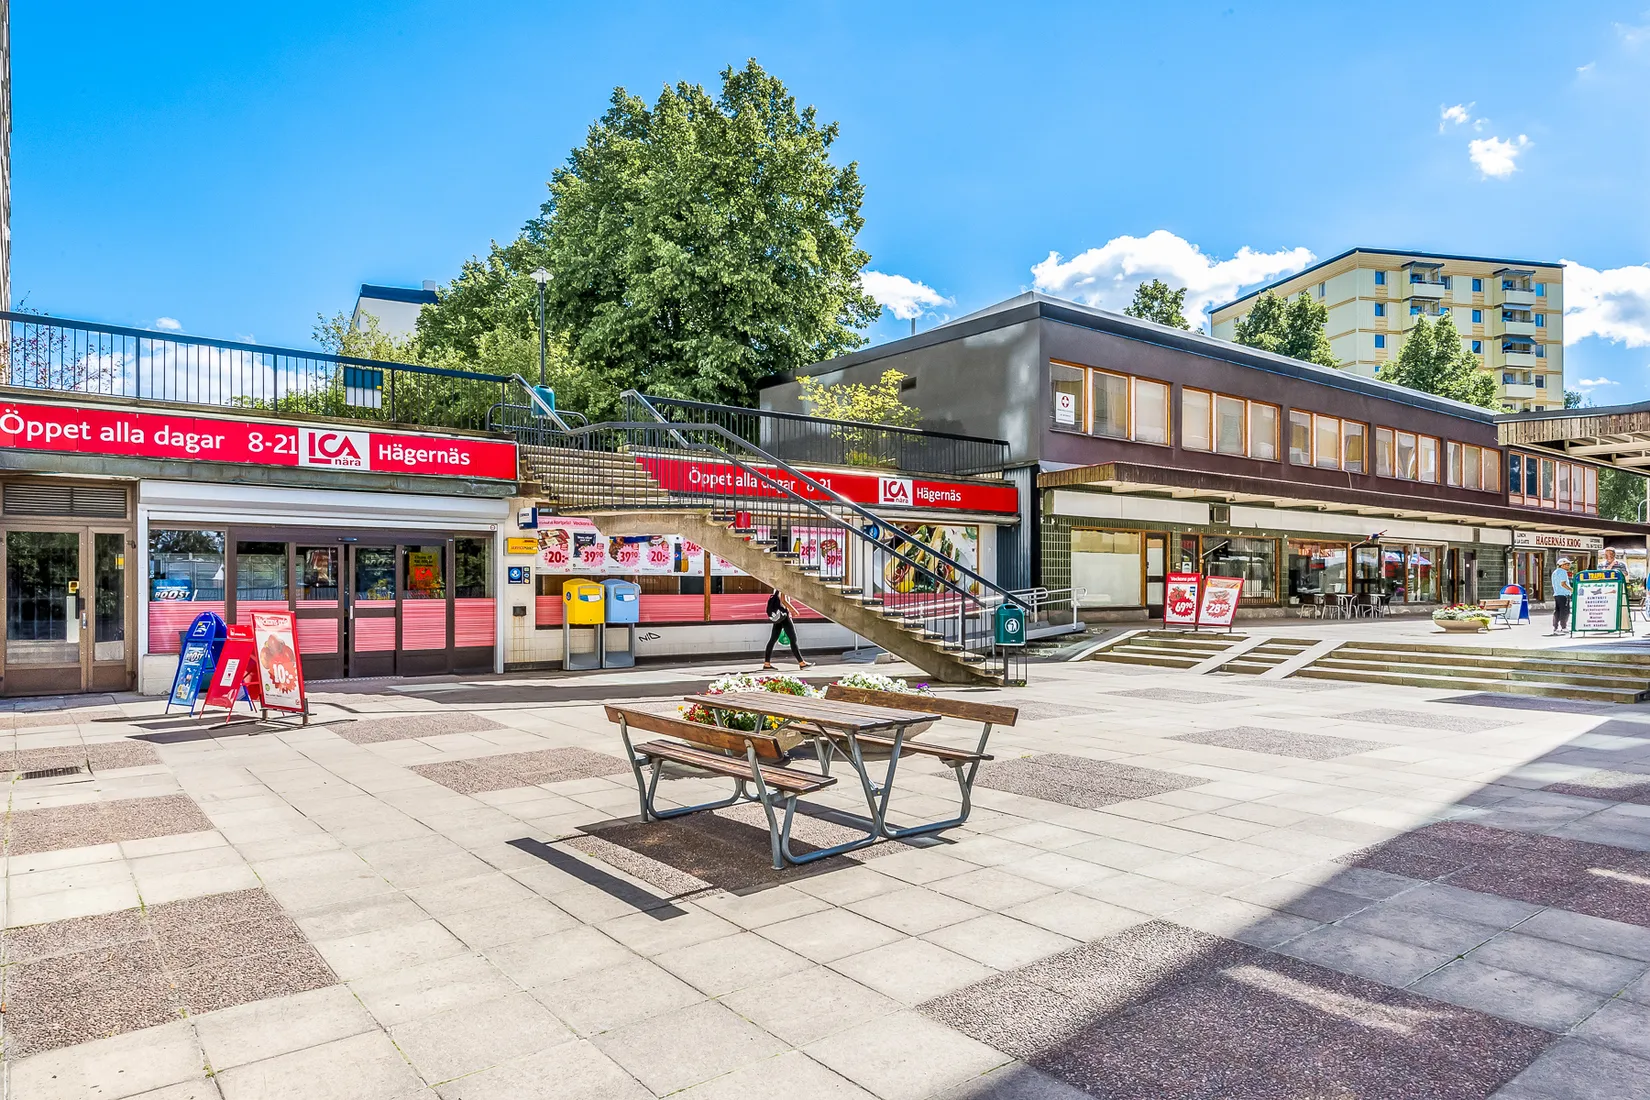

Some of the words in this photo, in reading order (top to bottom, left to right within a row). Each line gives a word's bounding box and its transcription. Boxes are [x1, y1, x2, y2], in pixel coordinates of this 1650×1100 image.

[0, 408, 92, 443] Öppet
[99, 421, 145, 444] alla
[154, 425, 225, 454] dagar
[247, 432, 298, 455] 8-21
[308, 432, 361, 460] ICA
[334, 457, 362, 467] nära
[378, 444, 471, 466] Hägernäs
[688, 466, 733, 489] Öppet
[735, 471, 758, 488] alla
[883, 480, 909, 498] ICA
[916, 487, 962, 502] Hägernäs
[1566, 538, 1582, 548] KROG
[547, 550, 569, 563] 20:-
[651, 551, 669, 562] 20:-
